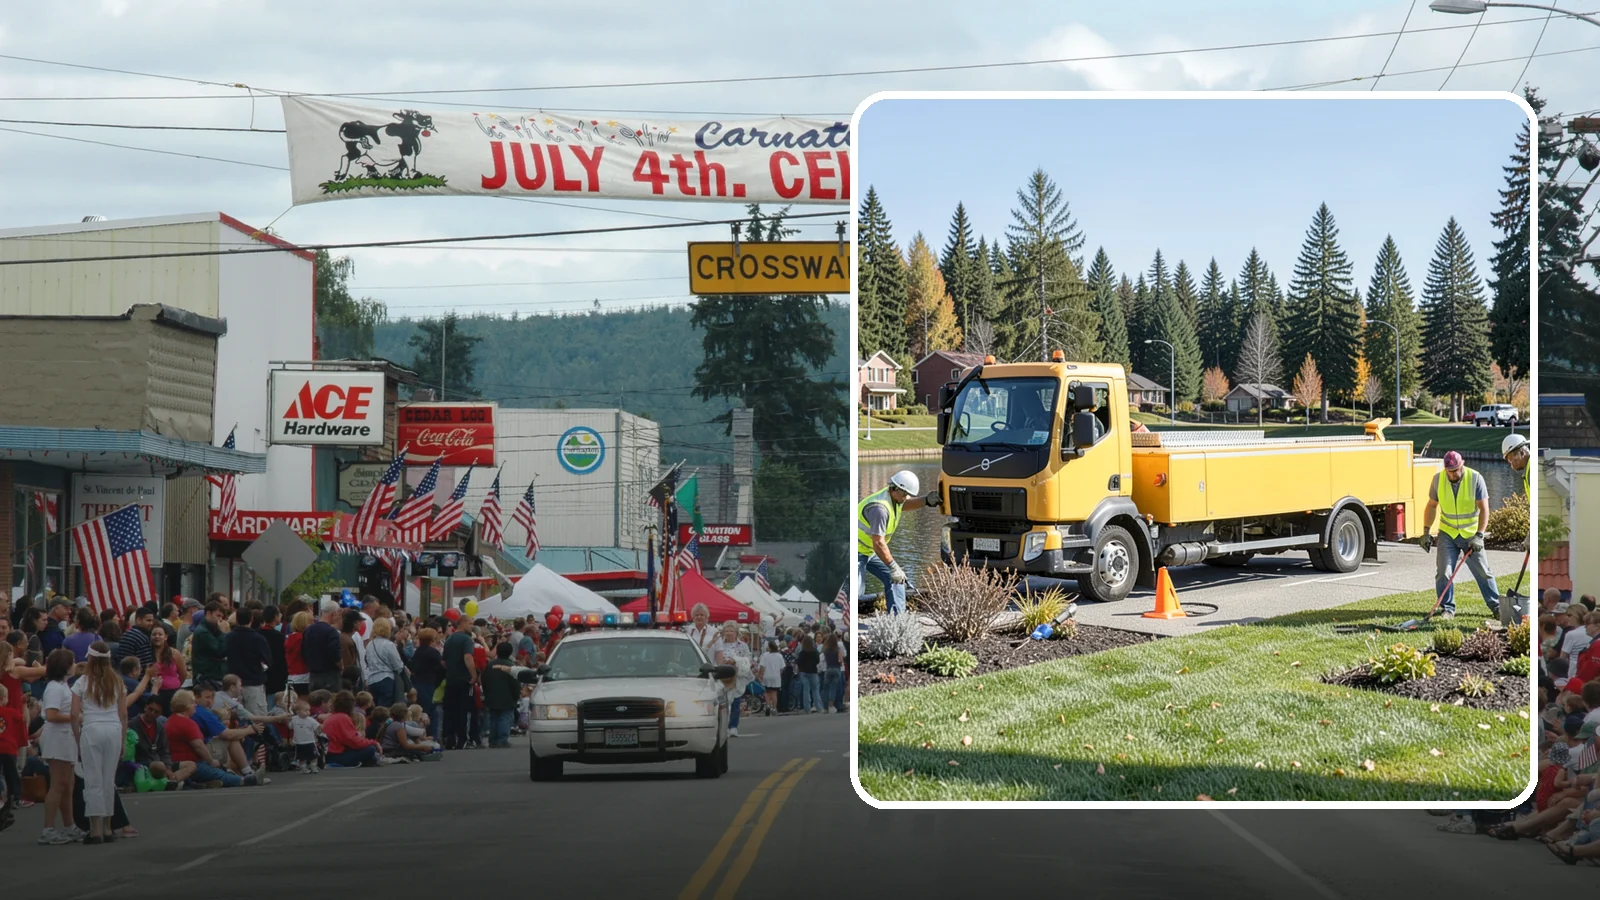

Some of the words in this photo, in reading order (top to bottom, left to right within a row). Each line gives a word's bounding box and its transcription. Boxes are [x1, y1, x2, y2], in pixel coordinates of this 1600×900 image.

[481, 141, 604, 192] JULY
[632, 150, 746, 198] 4th.
[697, 254, 850, 280] CROSSWA
[283, 380, 373, 420] ACE
[405, 409, 453, 422] CEDAR
[283, 421, 371, 436] Hardware
[95, 485, 124, 494] Vincent
[126, 485, 136, 494] de
[137, 486, 155, 495] Paul
[688, 526, 741, 535] CRNATION
